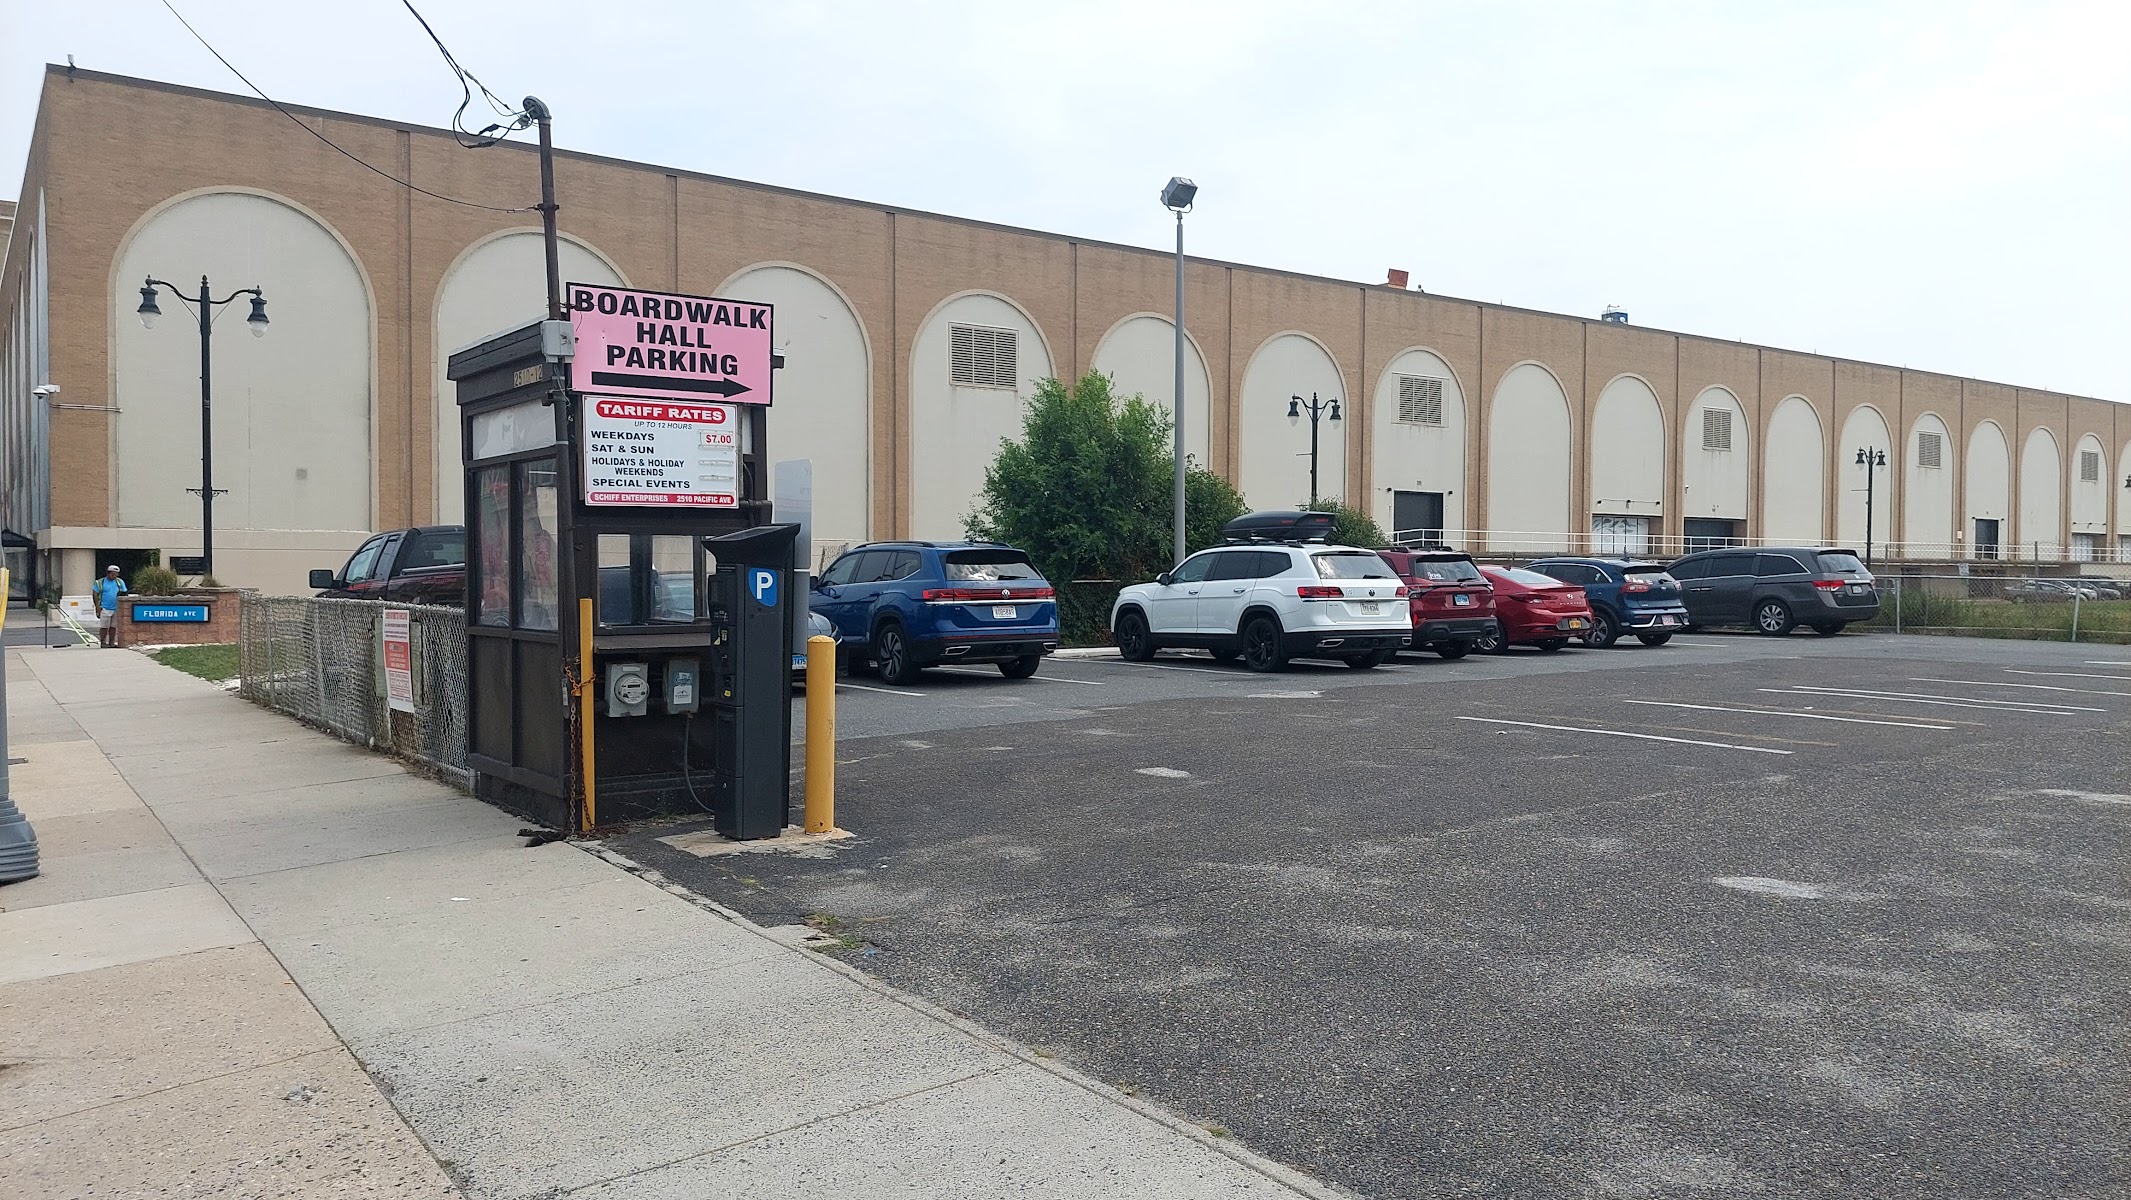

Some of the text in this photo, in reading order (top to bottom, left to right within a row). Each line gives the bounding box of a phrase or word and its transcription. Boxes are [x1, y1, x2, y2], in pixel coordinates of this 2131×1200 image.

[574, 289, 767, 330] BOARDWALK
[636, 321, 712, 349] HALL
[606, 344, 738, 376] PARKING
[600, 403, 723, 421] TARIFF RATES
[646, 421, 656, 429] TO
[658, 421, 666, 429] 12
[667, 422, 693, 430] HOURS
[591, 430, 655, 441] WEEKDAYS
[705, 434, 732, 444] $7.00
[591, 443, 655, 454] SAT & SUN
[591, 457, 685, 468] HOLIDAYS & HOLIDAY
[614, 467, 664, 476] WEEKENDS
[592, 478, 691, 489] SPECIAL EVENTS
[594, 493, 732, 504] SCHIFF ENTERPRISES 2510 PACIFIC AVE
[756, 572, 773, 600] P
[143, 610, 178, 618] FLORIDA
